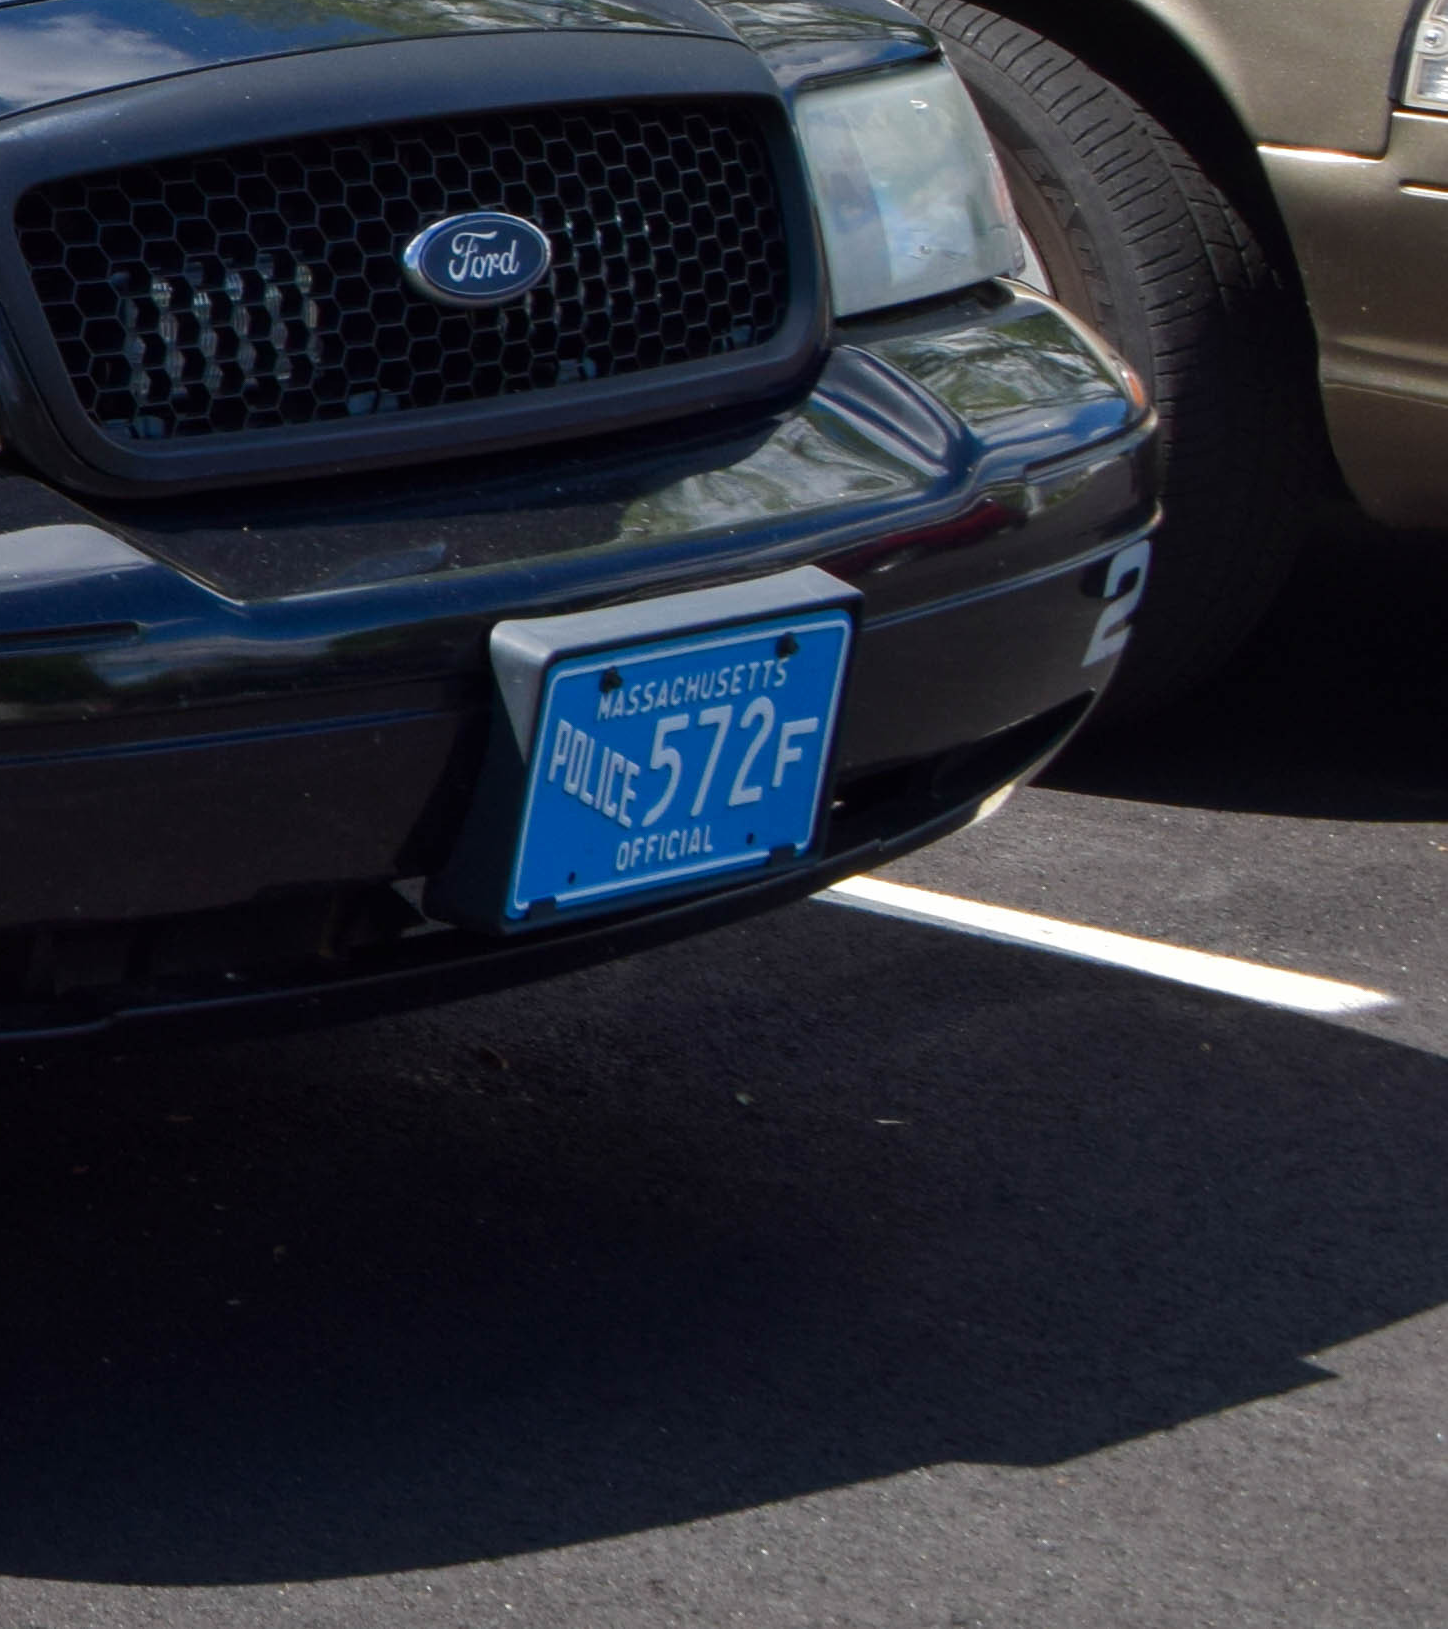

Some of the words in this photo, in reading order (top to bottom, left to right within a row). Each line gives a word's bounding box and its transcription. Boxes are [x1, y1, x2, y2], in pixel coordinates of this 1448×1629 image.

[448, 230, 521, 282] Ford
[1080, 538, 1153, 668] 2
[596, 655, 789, 723] MASSACHUSETTS
[547, 718, 641, 830] POLICE
[640, 694, 820, 830] 572F
[615, 823, 715, 873] OFFICIAL
